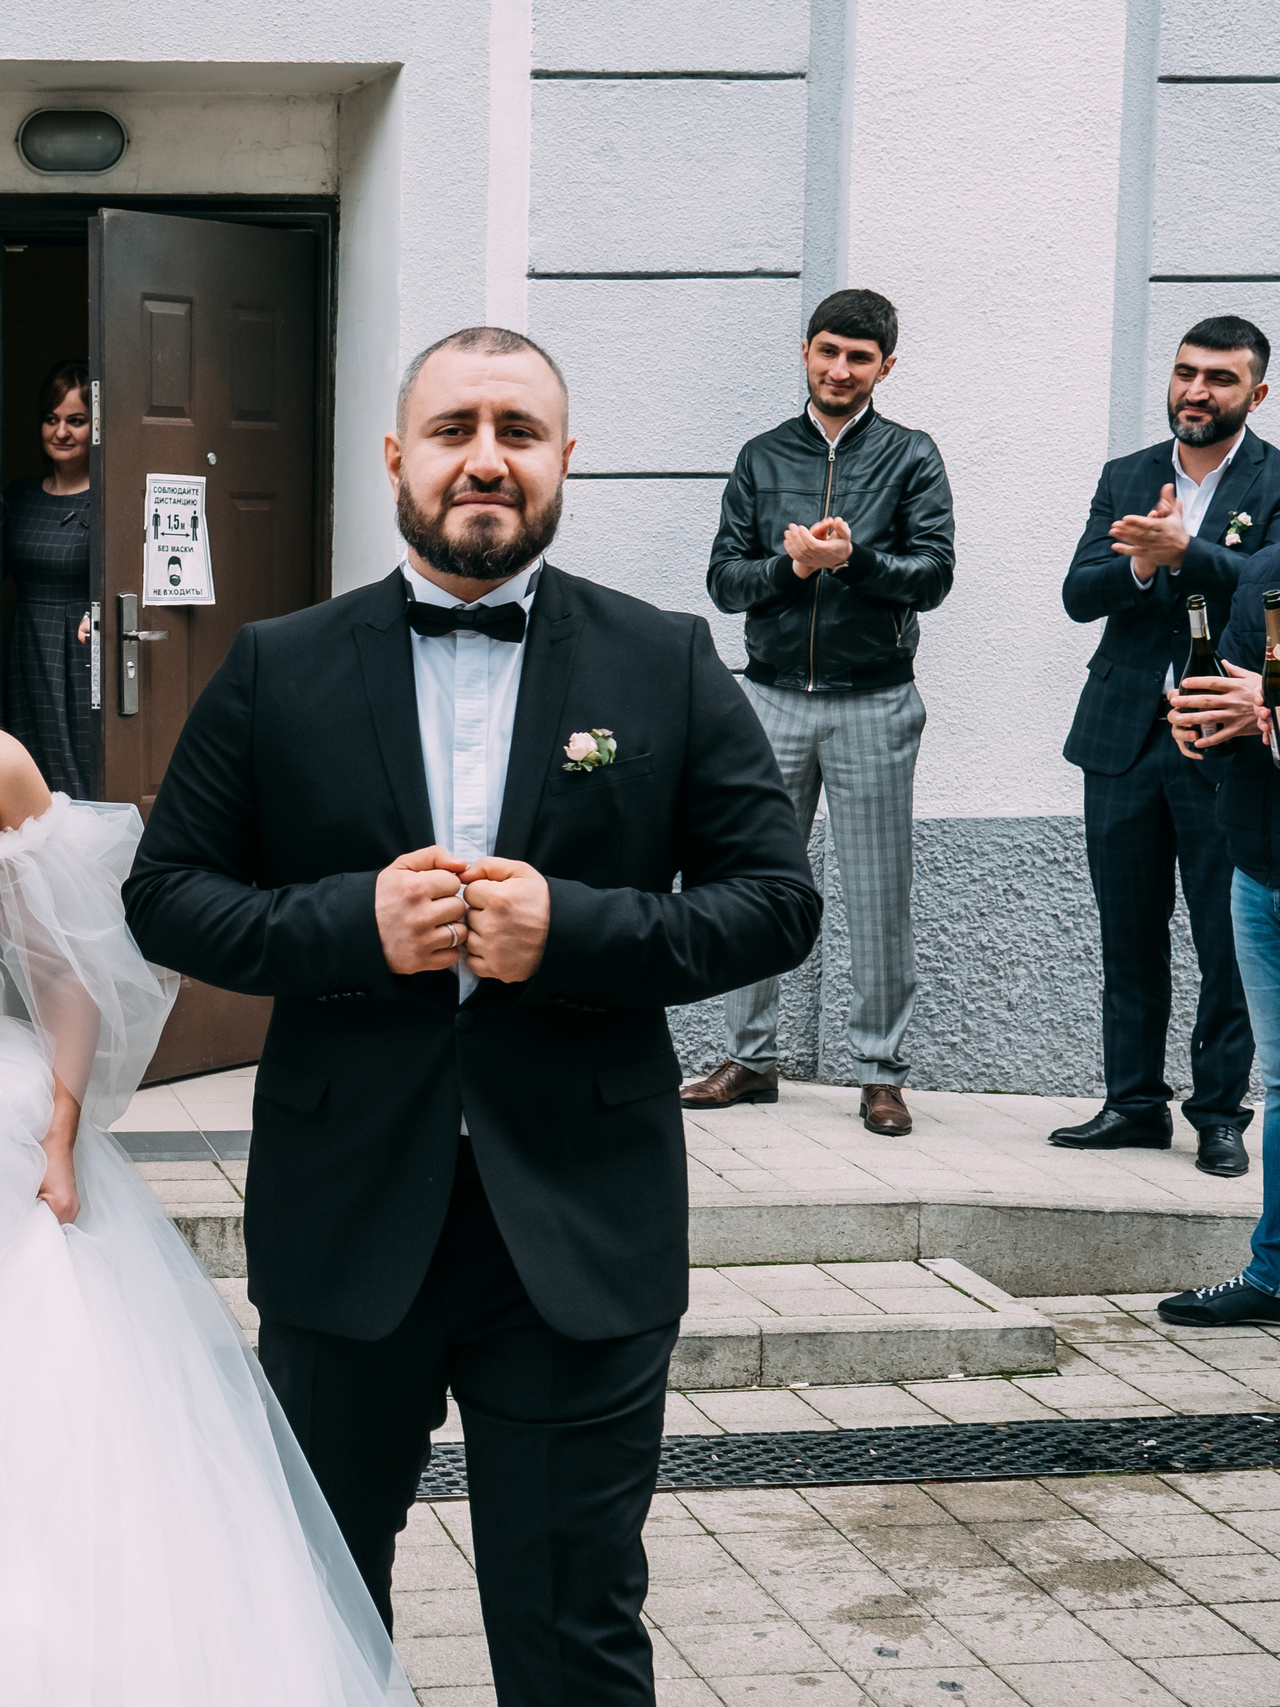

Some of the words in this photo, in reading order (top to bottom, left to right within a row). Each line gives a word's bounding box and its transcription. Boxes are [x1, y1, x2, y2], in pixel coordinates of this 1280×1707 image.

[153, 486, 199, 496] СОБЛЮДАЙТЕ
[154, 497, 198, 506] ДИСТАНЦИЮ
[167, 514, 180, 531] 1,5
[170, 545, 195, 553] МАСКИ
[153, 588, 162, 596] НЕ
[163, 589, 203, 597] ВХОДИТЬ!
